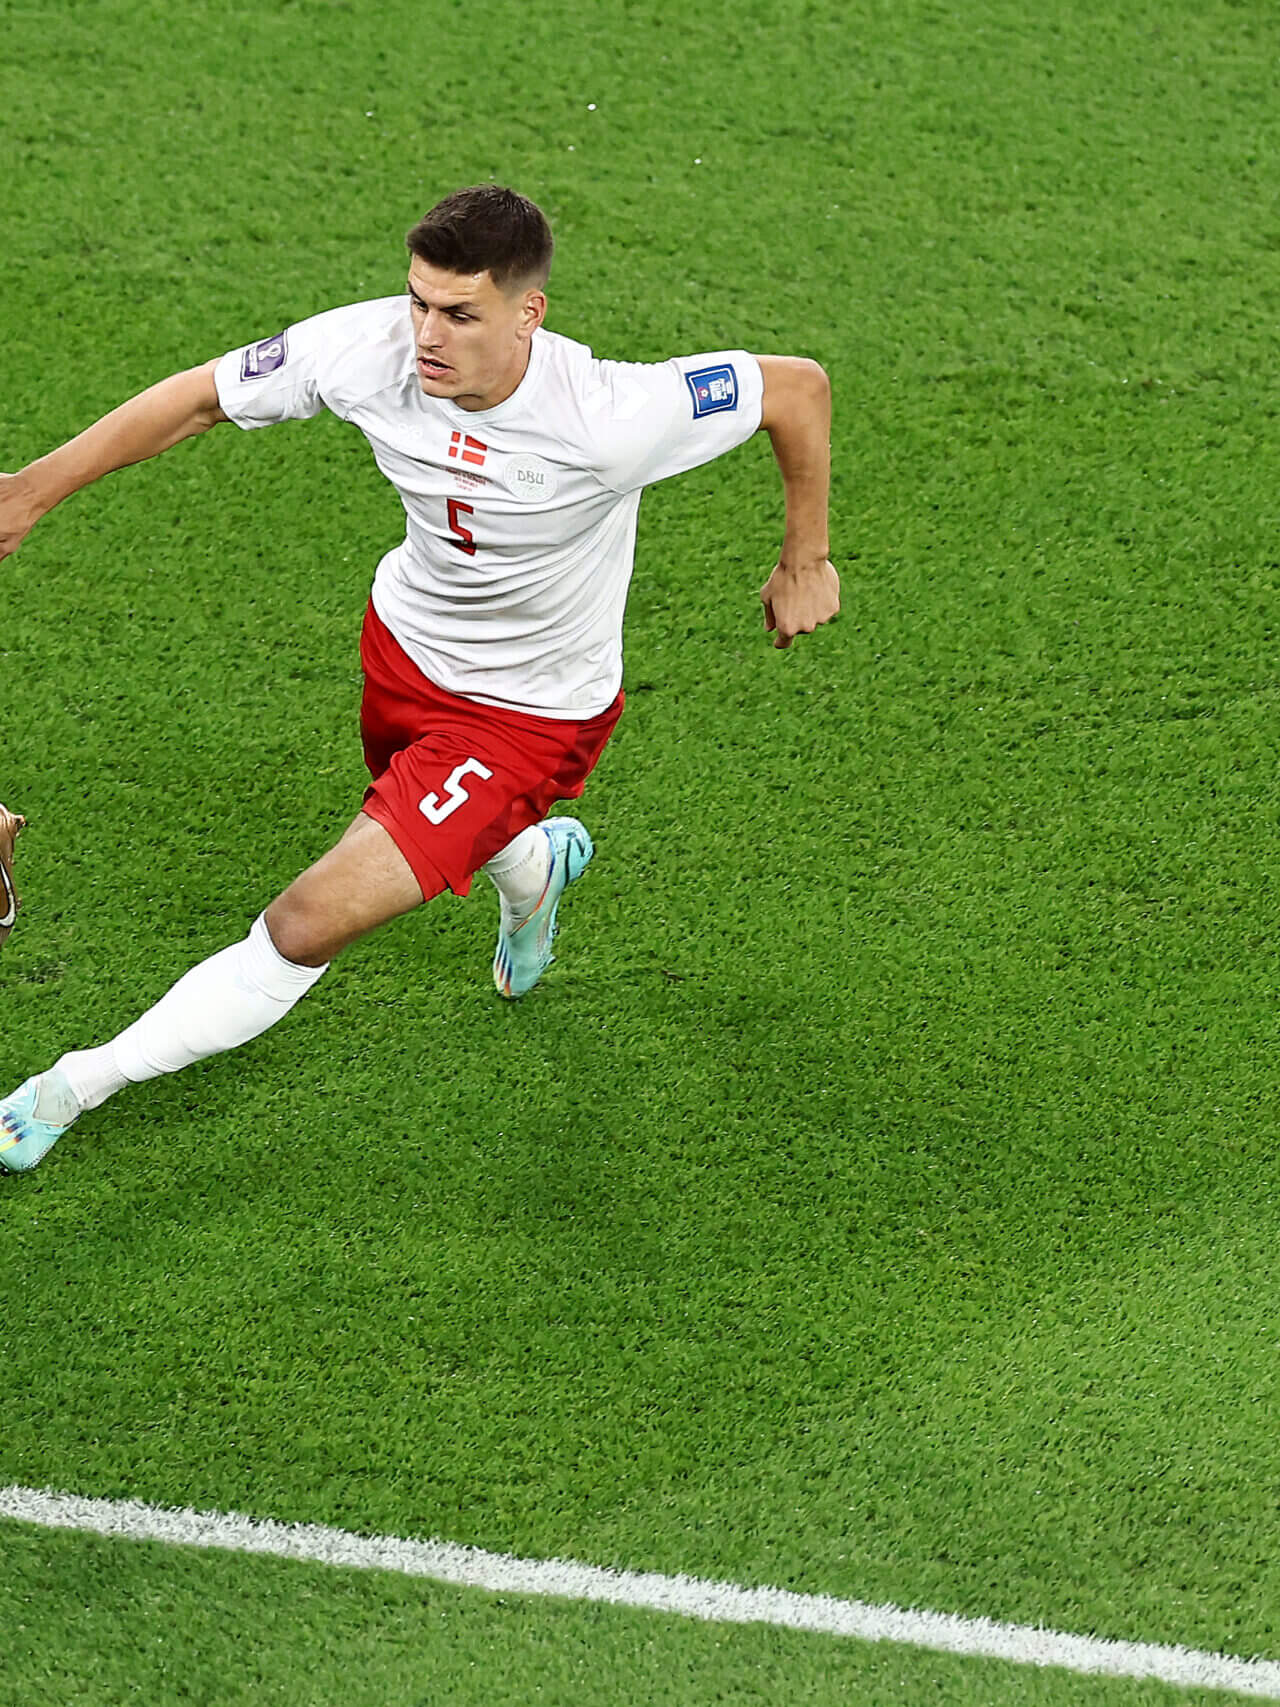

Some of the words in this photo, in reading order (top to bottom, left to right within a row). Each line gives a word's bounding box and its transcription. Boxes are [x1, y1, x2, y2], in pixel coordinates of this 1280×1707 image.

[517, 470, 545, 485] DBU
[447, 498, 477, 556] 5
[418, 757, 494, 825] 5
